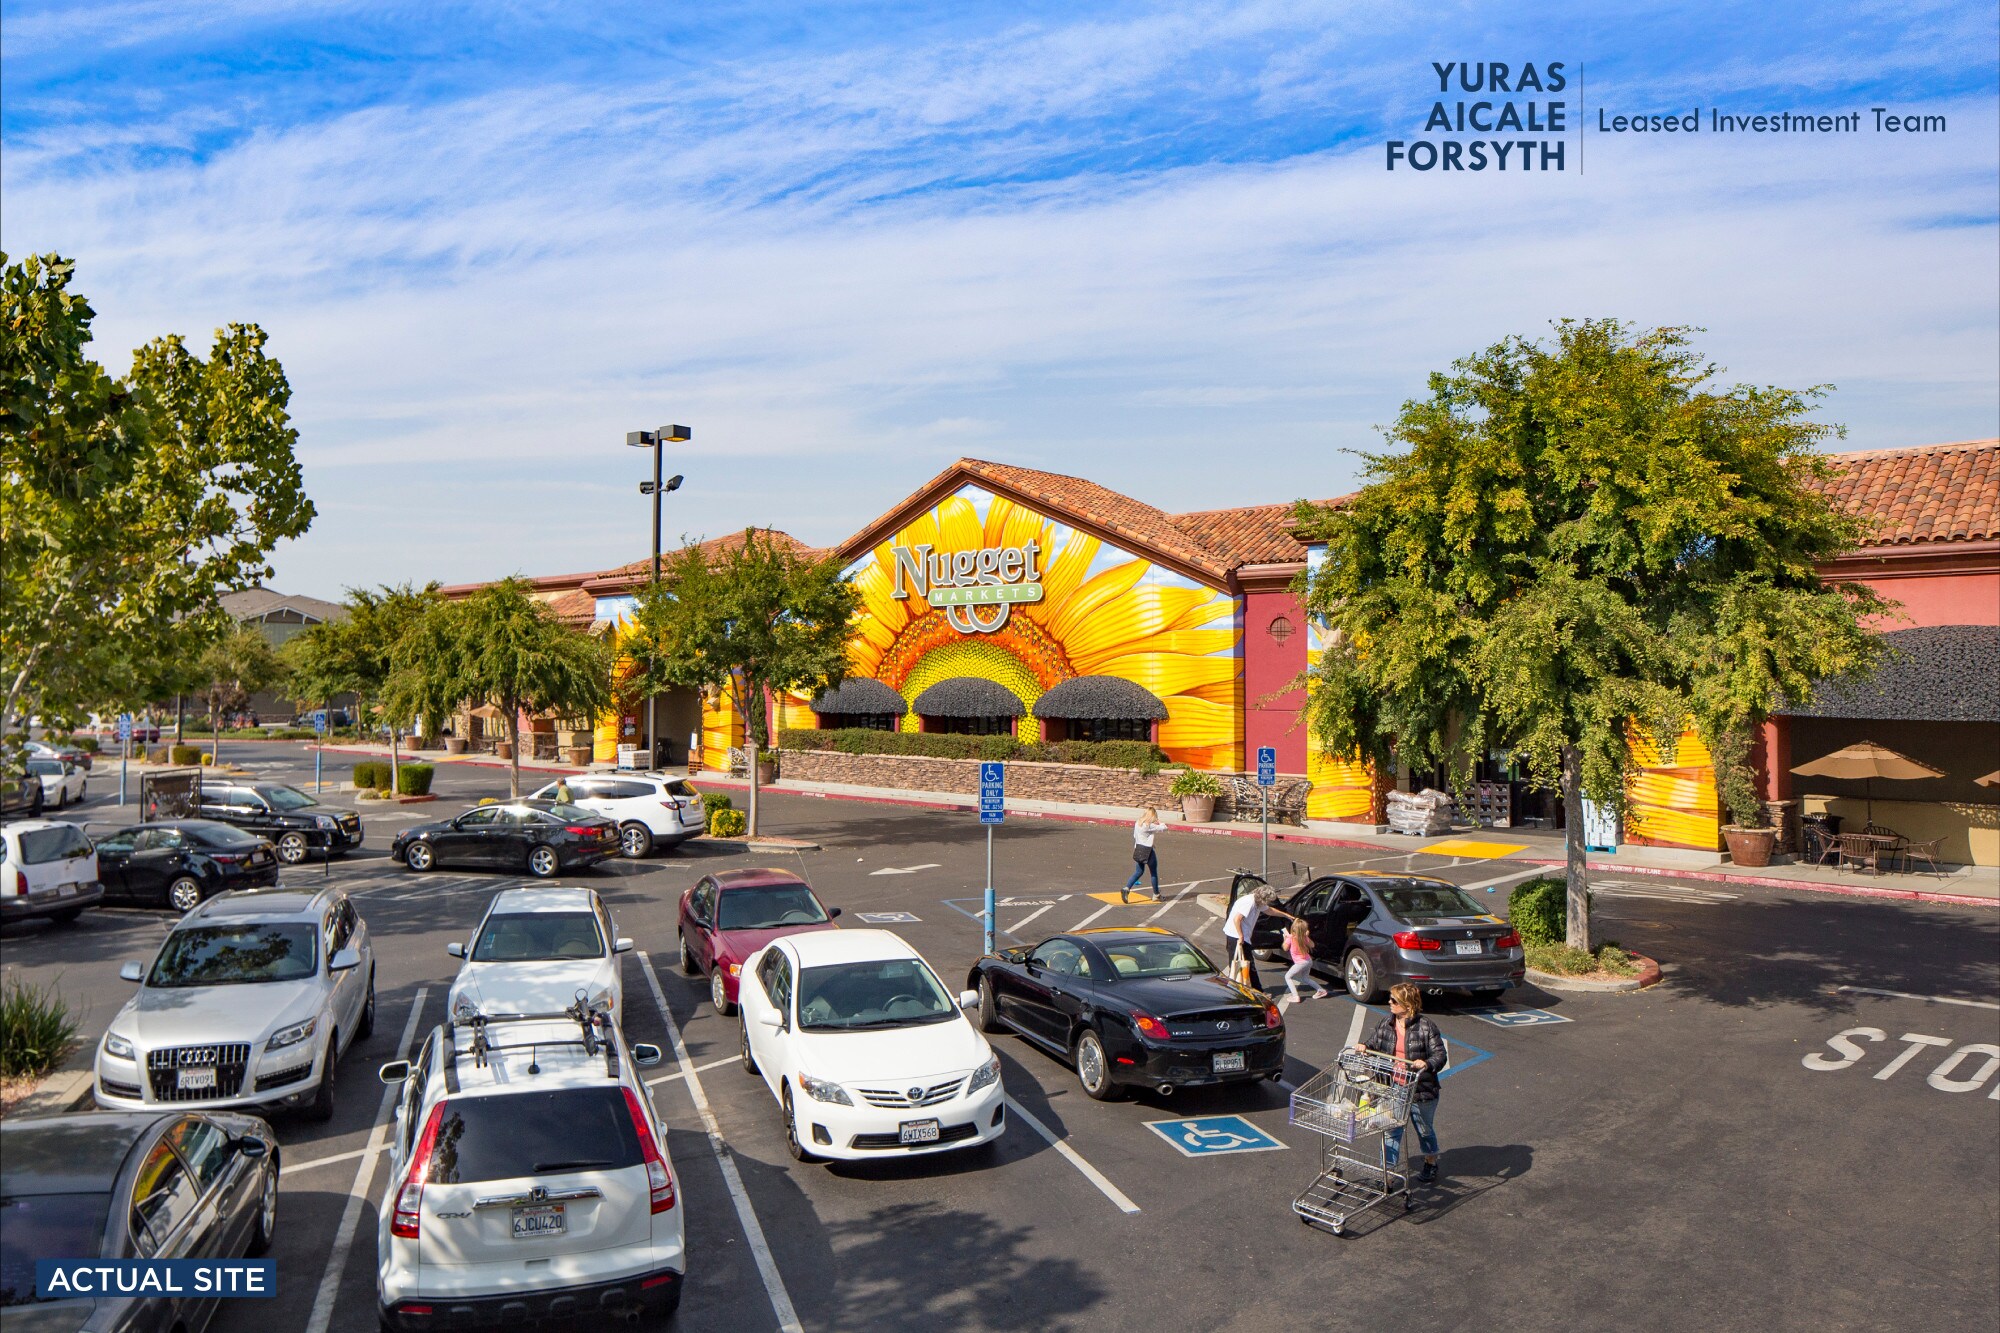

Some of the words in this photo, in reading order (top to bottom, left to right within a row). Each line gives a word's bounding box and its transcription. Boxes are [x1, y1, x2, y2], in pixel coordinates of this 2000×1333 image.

[890, 538, 1041, 633] Nugget
[934, 587, 1036, 602] MARKETS
[982, 781, 1003, 789] PARKING
[1801, 1027, 1999, 1100] STO
[903, 1127, 937, 1141] 6WIX568
[514, 1214, 562, 1232] 6JCU420
